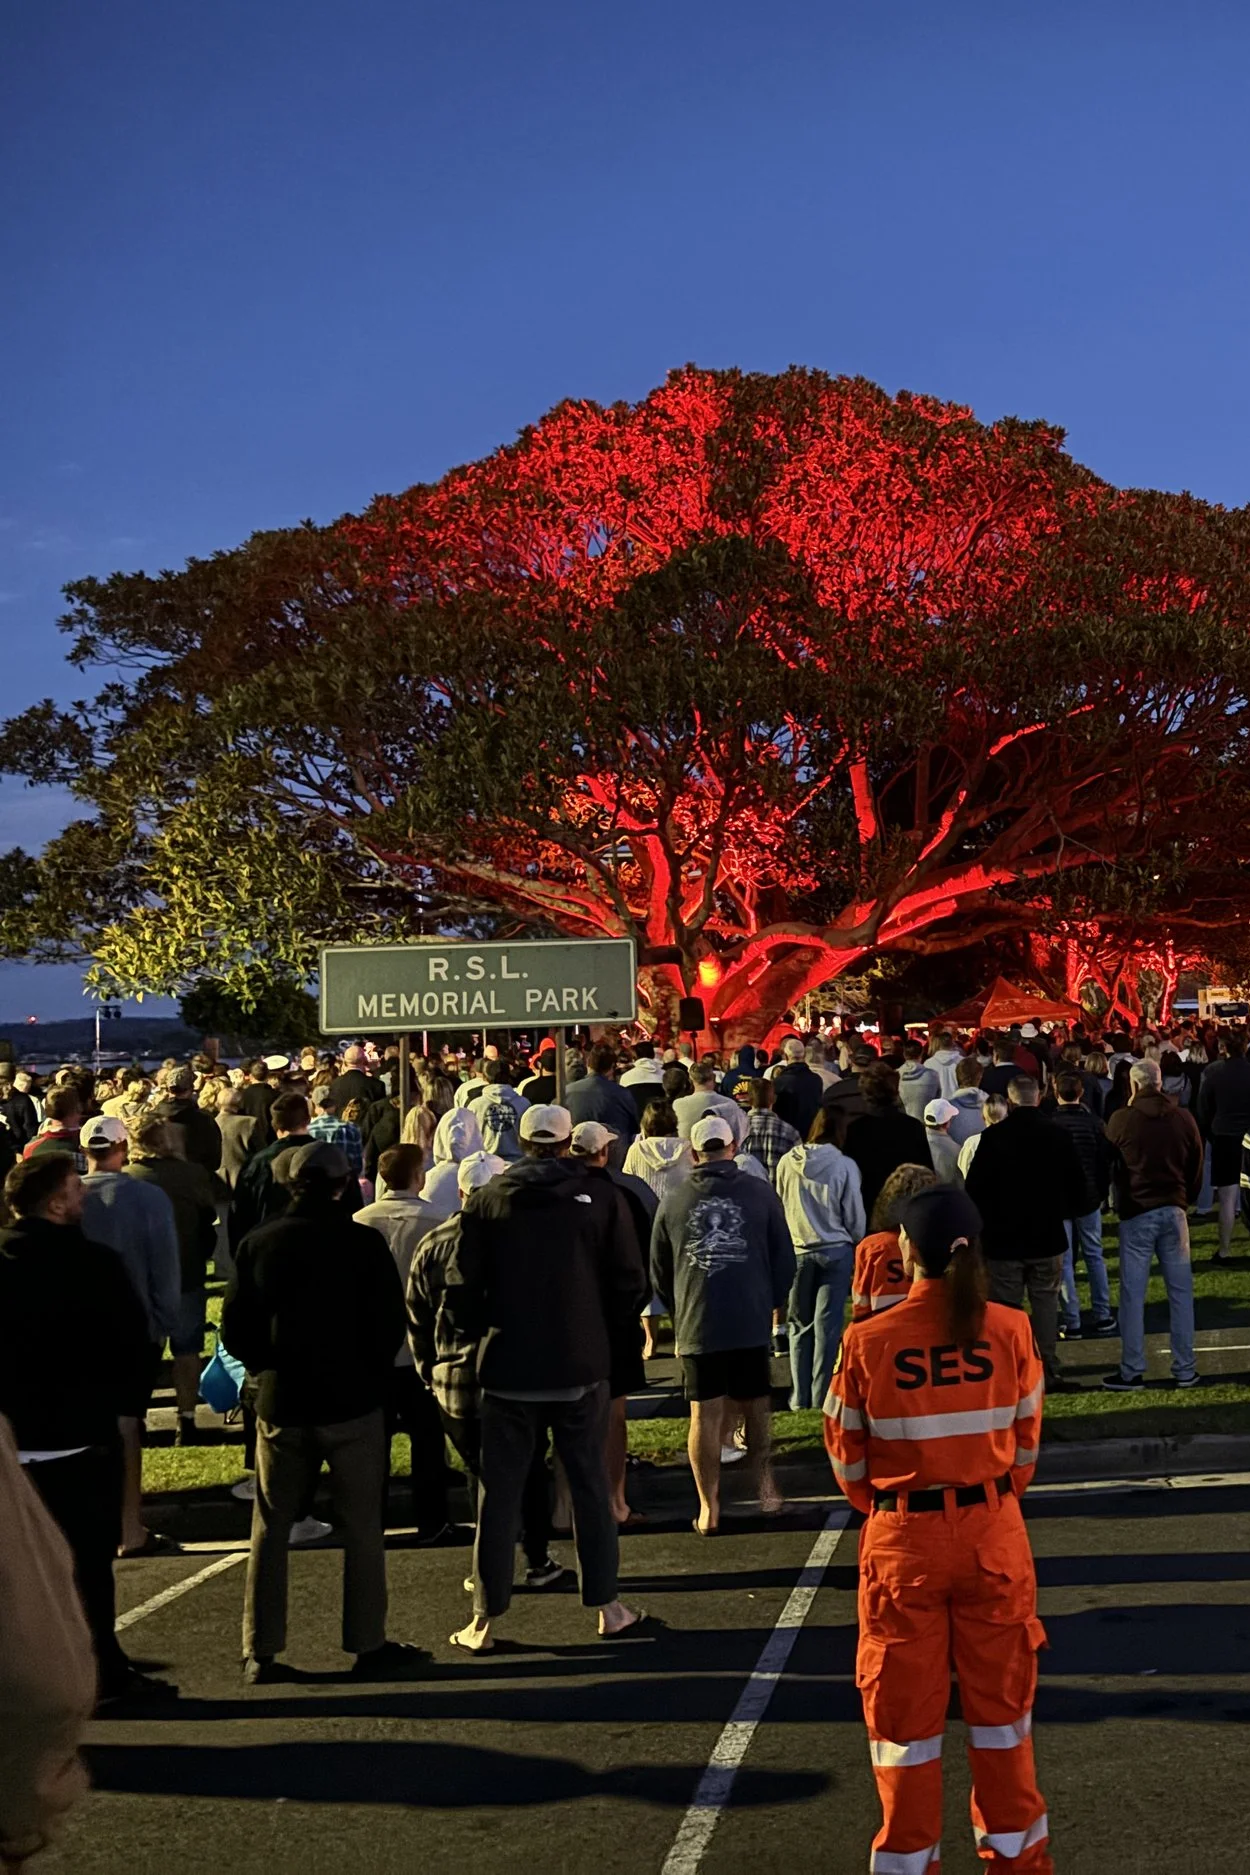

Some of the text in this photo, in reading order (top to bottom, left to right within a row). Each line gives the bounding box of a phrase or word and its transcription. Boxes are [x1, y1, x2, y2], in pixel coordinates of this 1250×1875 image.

[428, 954, 529, 982] R.S.L.
[357, 987, 599, 1018] MEMORIAL PARK
[894, 1340, 994, 1391] SES
